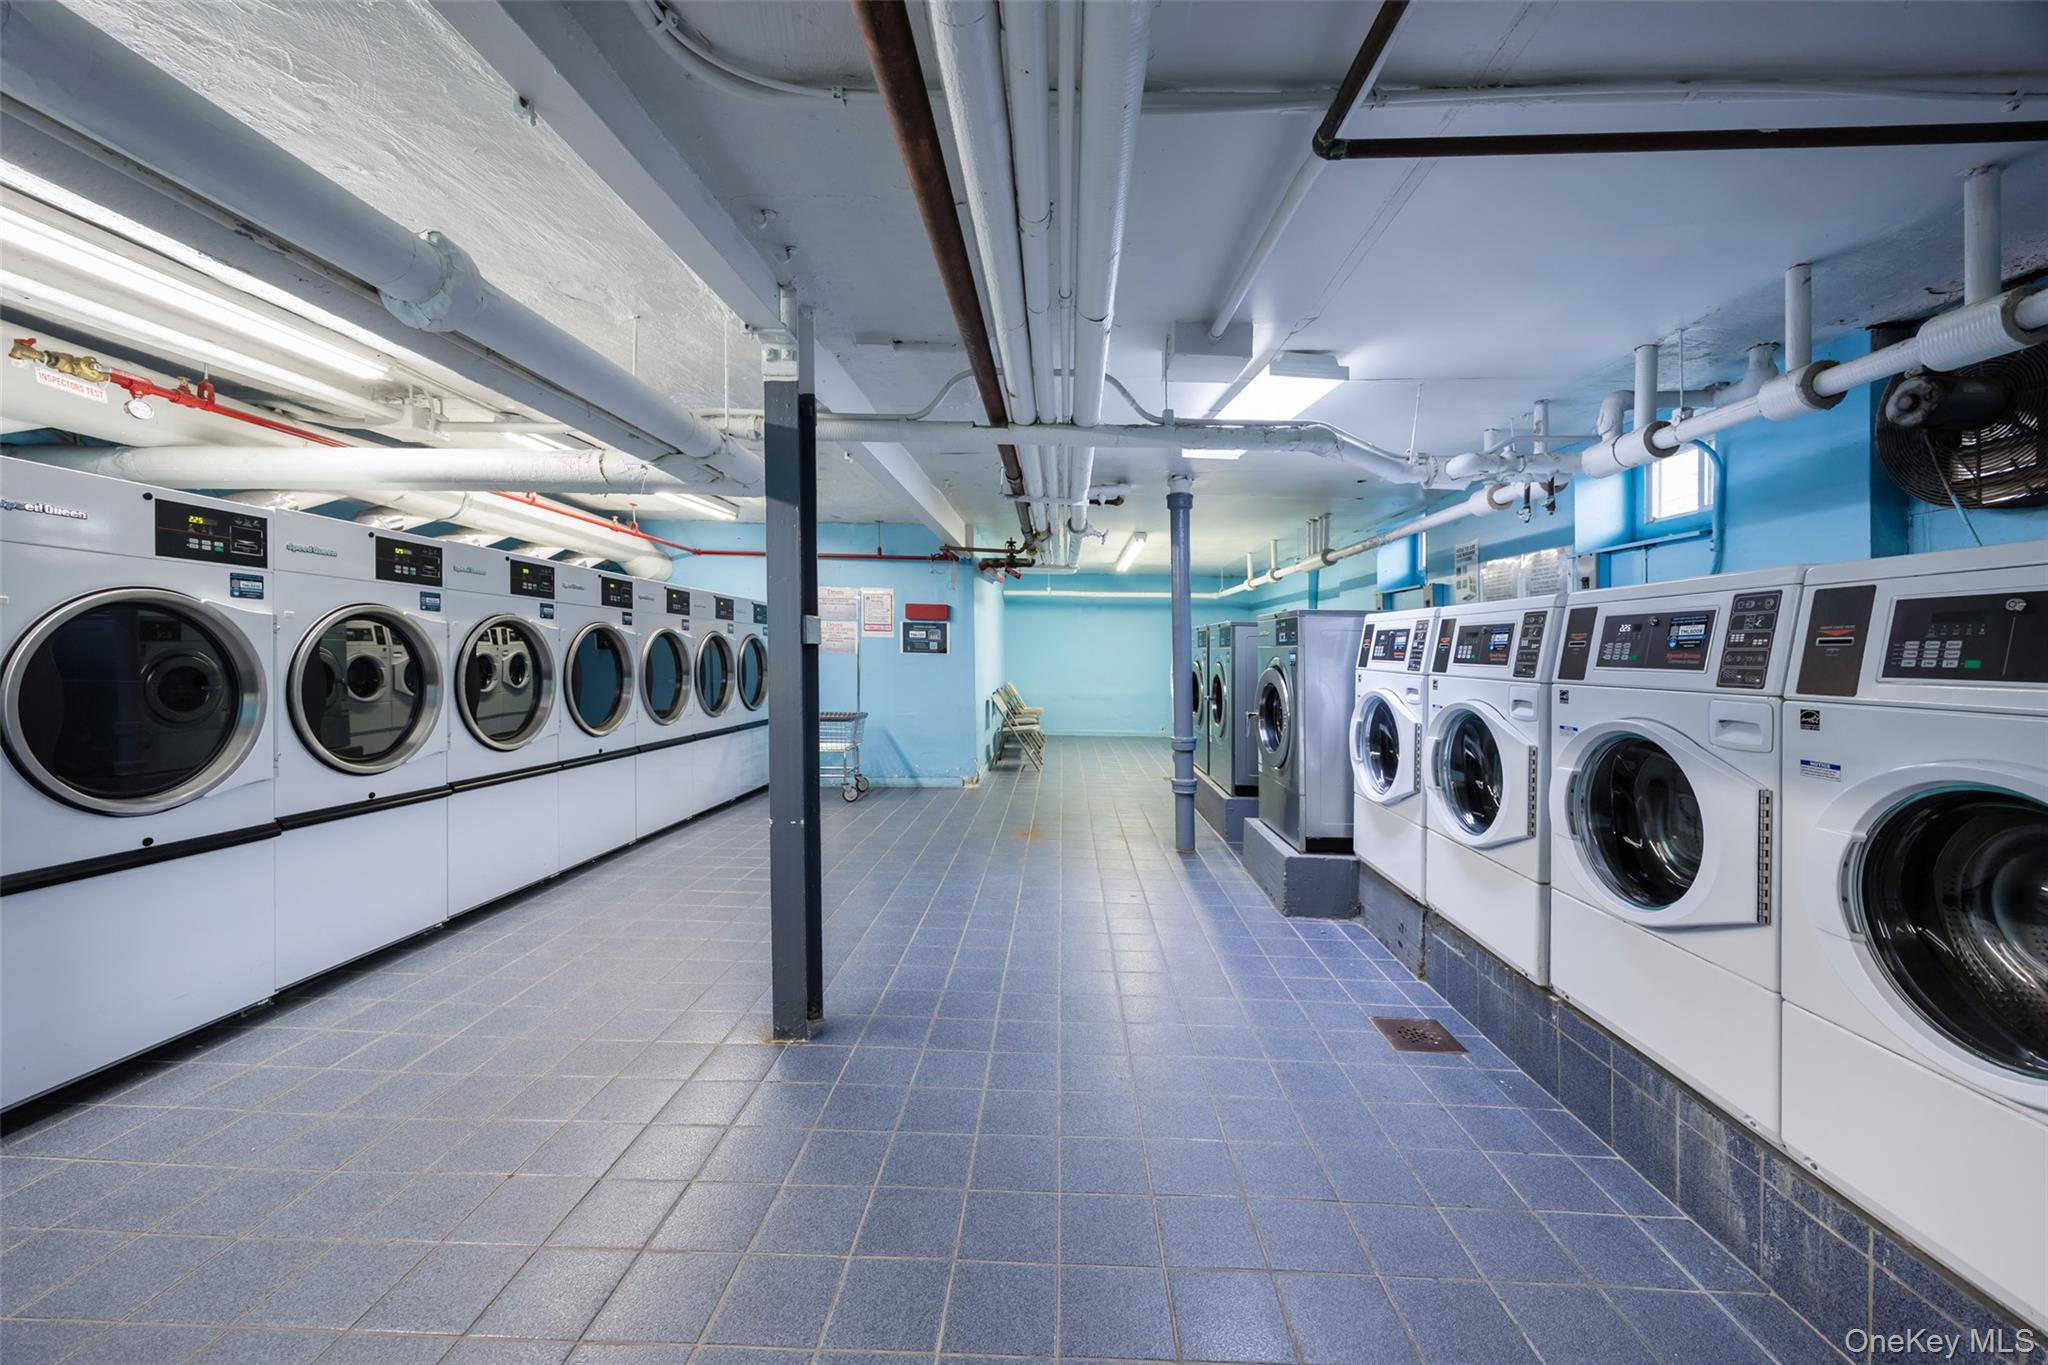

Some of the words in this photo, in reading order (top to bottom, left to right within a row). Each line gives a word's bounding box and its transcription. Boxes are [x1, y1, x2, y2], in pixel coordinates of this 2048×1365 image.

[38, 371, 86, 394] INSPECTORS
[86, 386, 105, 399] TEST
[43, 504, 88, 520] Queen
[1618, 623, 1632, 633] 225
